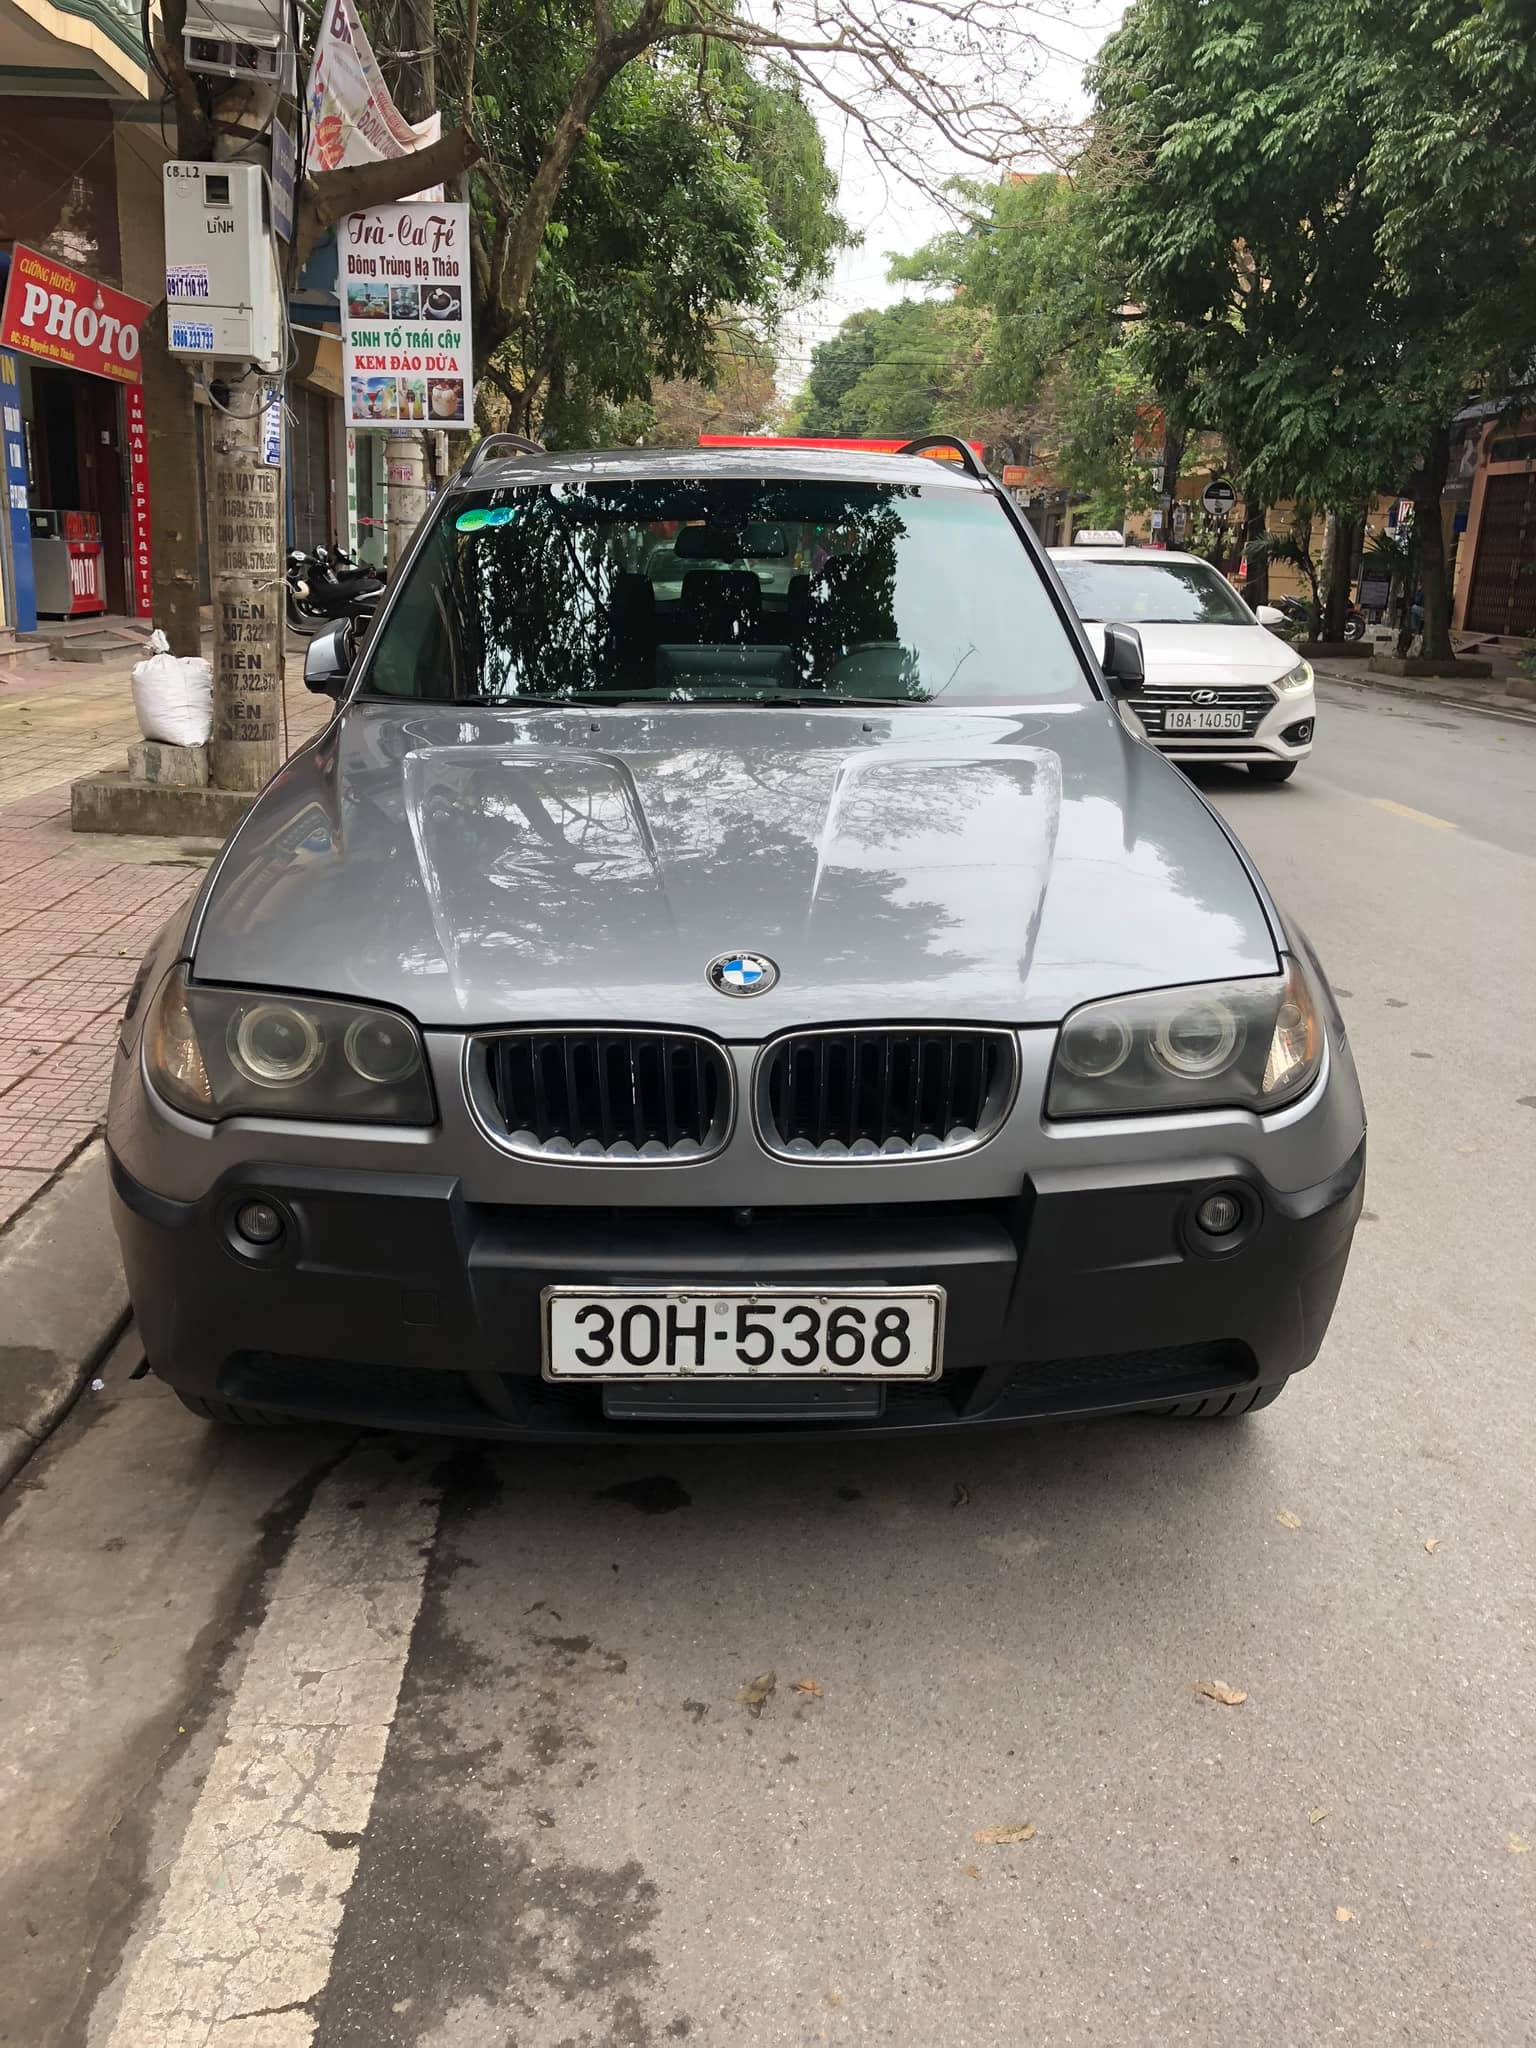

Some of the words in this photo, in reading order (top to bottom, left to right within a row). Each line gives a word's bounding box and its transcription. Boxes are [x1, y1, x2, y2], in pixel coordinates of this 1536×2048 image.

[348, 213, 384, 244] Trà
[347, 254, 377, 277] Đông
[379, 255, 411, 278] Trùng
[414, 257, 429, 281] Hạ
[432, 255, 460, 277] Thảo
[20, 282, 139, 360] PHOTO
[351, 331, 380, 347] SINH
[384, 325, 402, 348] TỐ
[405, 328, 433, 348] TRÁI
[437, 329, 461, 349] CÂY
[354, 355, 386, 370] KEM
[425, 352, 459, 371] DỪA
[574, 1304, 912, 1367] 30H-5368
